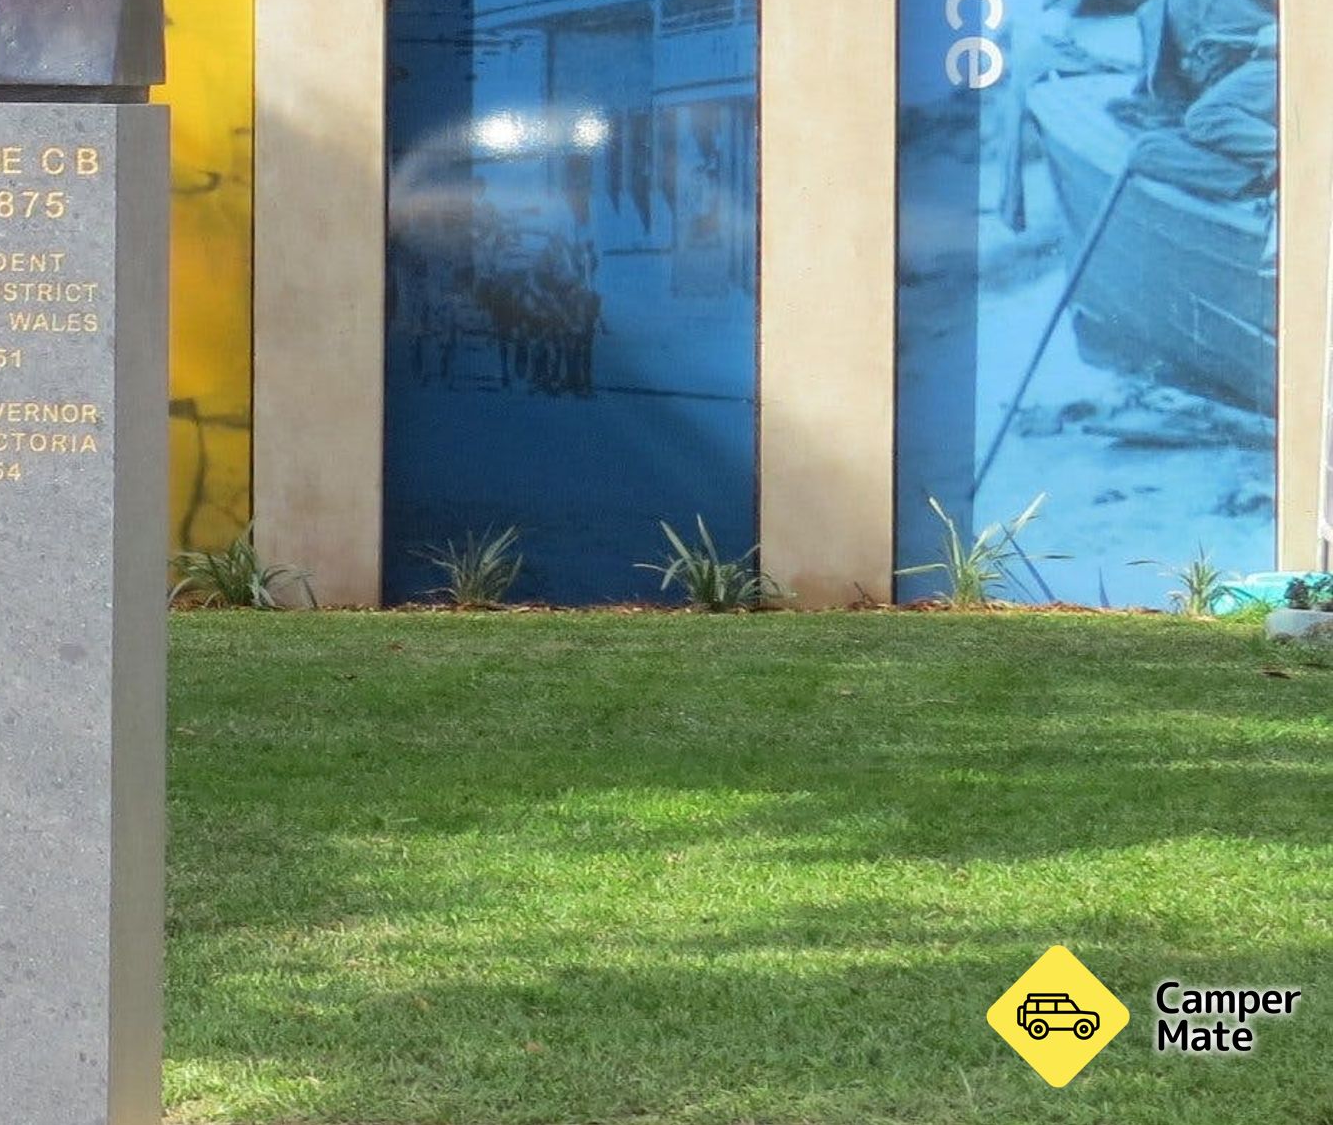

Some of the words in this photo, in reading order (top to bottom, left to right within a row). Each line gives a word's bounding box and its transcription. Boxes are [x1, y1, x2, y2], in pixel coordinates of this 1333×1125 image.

[41, 146, 67, 177] C
[76, 146, 102, 177] B
[7, 311, 98, 332] WALES
